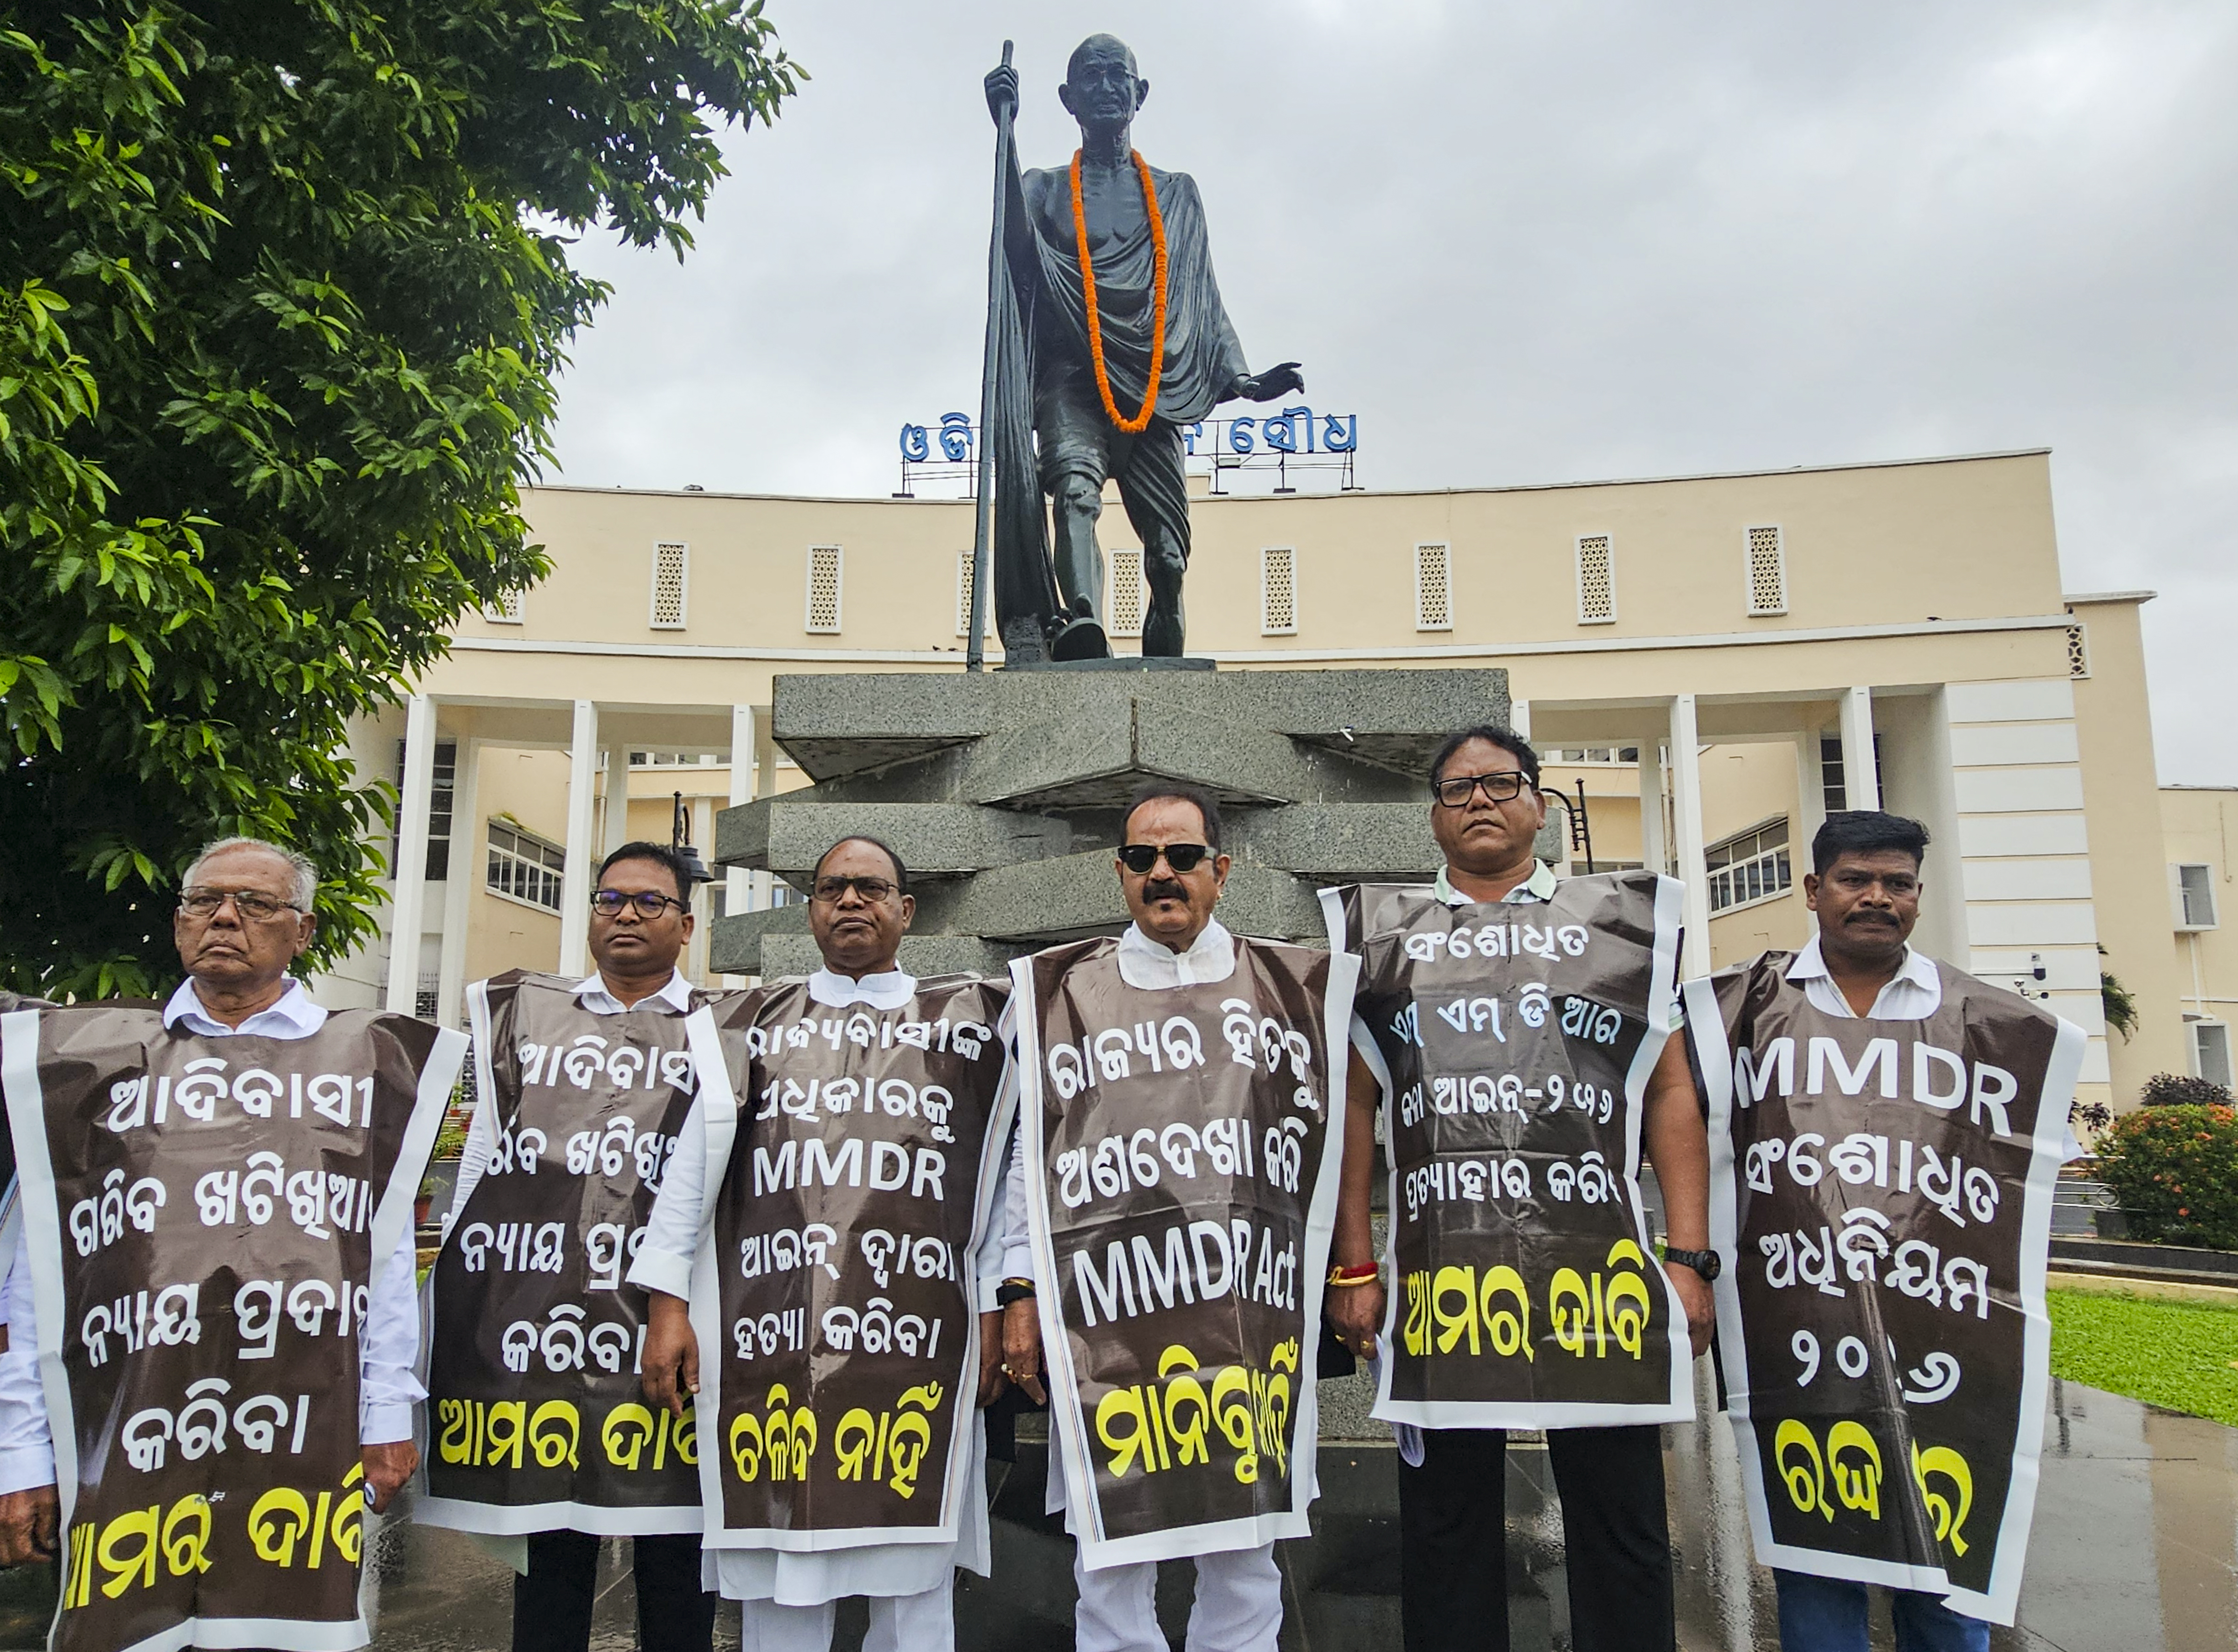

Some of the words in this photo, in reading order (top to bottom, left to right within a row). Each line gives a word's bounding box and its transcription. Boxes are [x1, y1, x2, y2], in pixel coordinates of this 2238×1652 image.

[1405, 924, 1589, 962] ସଂଶୋଧିତ
[1048, 1016, 1206, 1099] ରାଜ୍ୟର
[1437, 998, 1506, 1043] ଏମ୍
[1561, 996, 1622, 1045] ଆର
[108, 1058, 374, 1132] ଆଦିବାସୀ
[518, 1035, 696, 1095] ଆଦିବାସ
[1734, 1037, 2018, 1137] MMDR
[753, 1138, 946, 1201] MMDR
[1056, 1118, 1253, 1208] ଅଣଦେଖା
[1746, 1133, 1999, 1228] ସଂଶୋଧିତ
[69, 1168, 166, 1257] ଗରିବ
[194, 1151, 373, 1240] ଖଟିଖିଆ
[460, 1222, 566, 1273] ନ୍ୟାୟ
[1073, 1219, 1252, 1327] MMDR
[1253, 1227, 1296, 1311] Act
[82, 1283, 201, 1368] ନ୍ୟାୟ
[821, 1297, 941, 1359] କରିବା
[1404, 1265, 1534, 1363] ଆମର
[1549, 1238, 1650, 1360] ଦାବି
[1791, 1329, 1961, 1403] ୨୦୬
[122, 1377, 310, 1472] କରିବା
[439, 1399, 580, 1472] ଆମର
